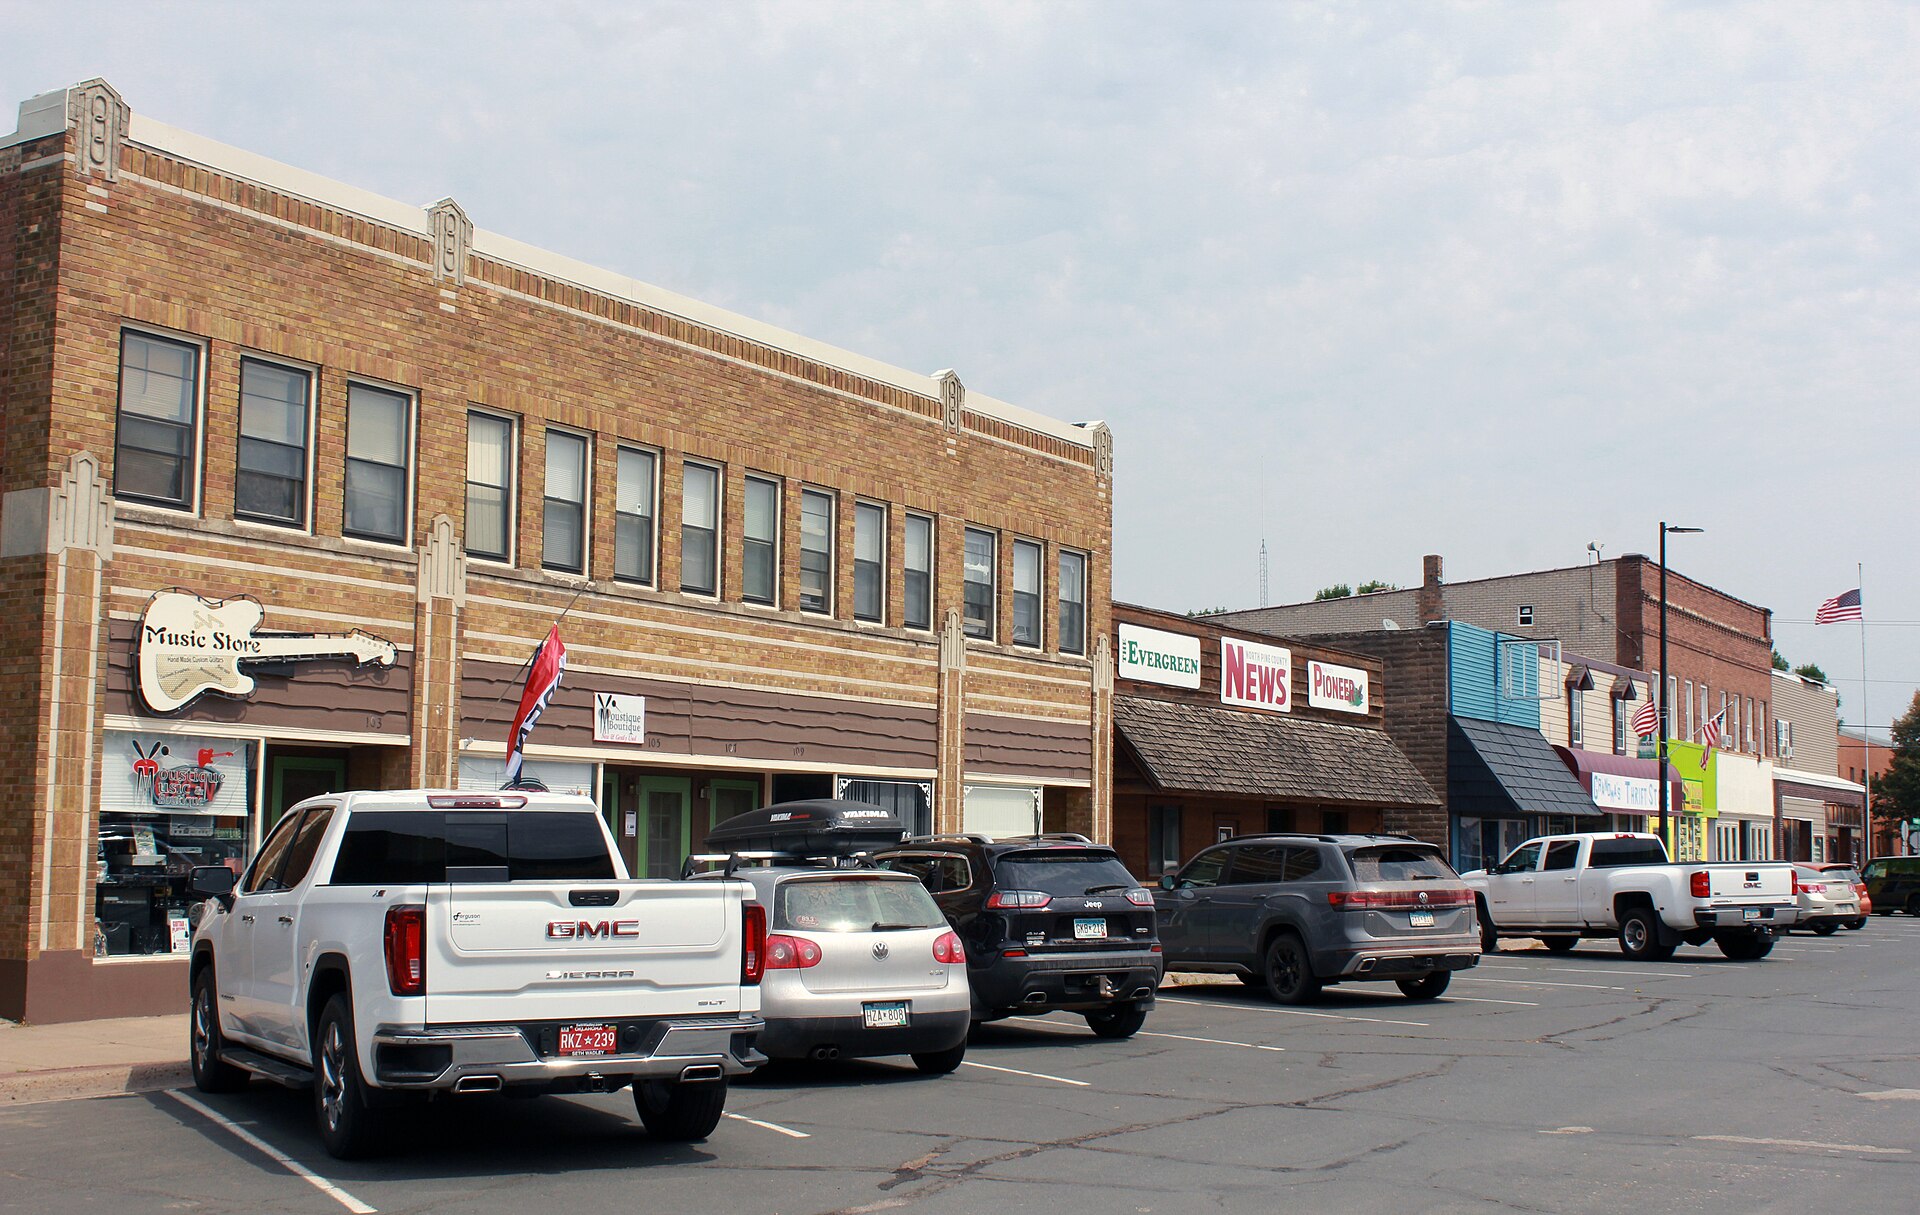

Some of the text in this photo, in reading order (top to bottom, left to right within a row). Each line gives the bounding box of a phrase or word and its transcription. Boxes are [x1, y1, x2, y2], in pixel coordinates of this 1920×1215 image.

[145, 625, 261, 653] Music Store
[1127, 640, 1199, 675] EVERGREEN
[1246, 650, 1288, 666] NORTH PINE COUNTY
[1225, 643, 1287, 706] NEWS
[1313, 663, 1355, 702] PIONEER
[609, 721, 641, 735] Boutique
[648, 738, 661, 748] 105
[1625, 781, 1647, 806] THRIFT
[842, 811, 889, 819] YAKIMA
[1084, 901, 1102, 909] Jeep
[547, 920, 639, 938] GMC
[546, 970, 634, 979] SIERRA
[866, 1009, 904, 1022] HZA 808
[561, 1032, 615, 1049] RKZ 239
